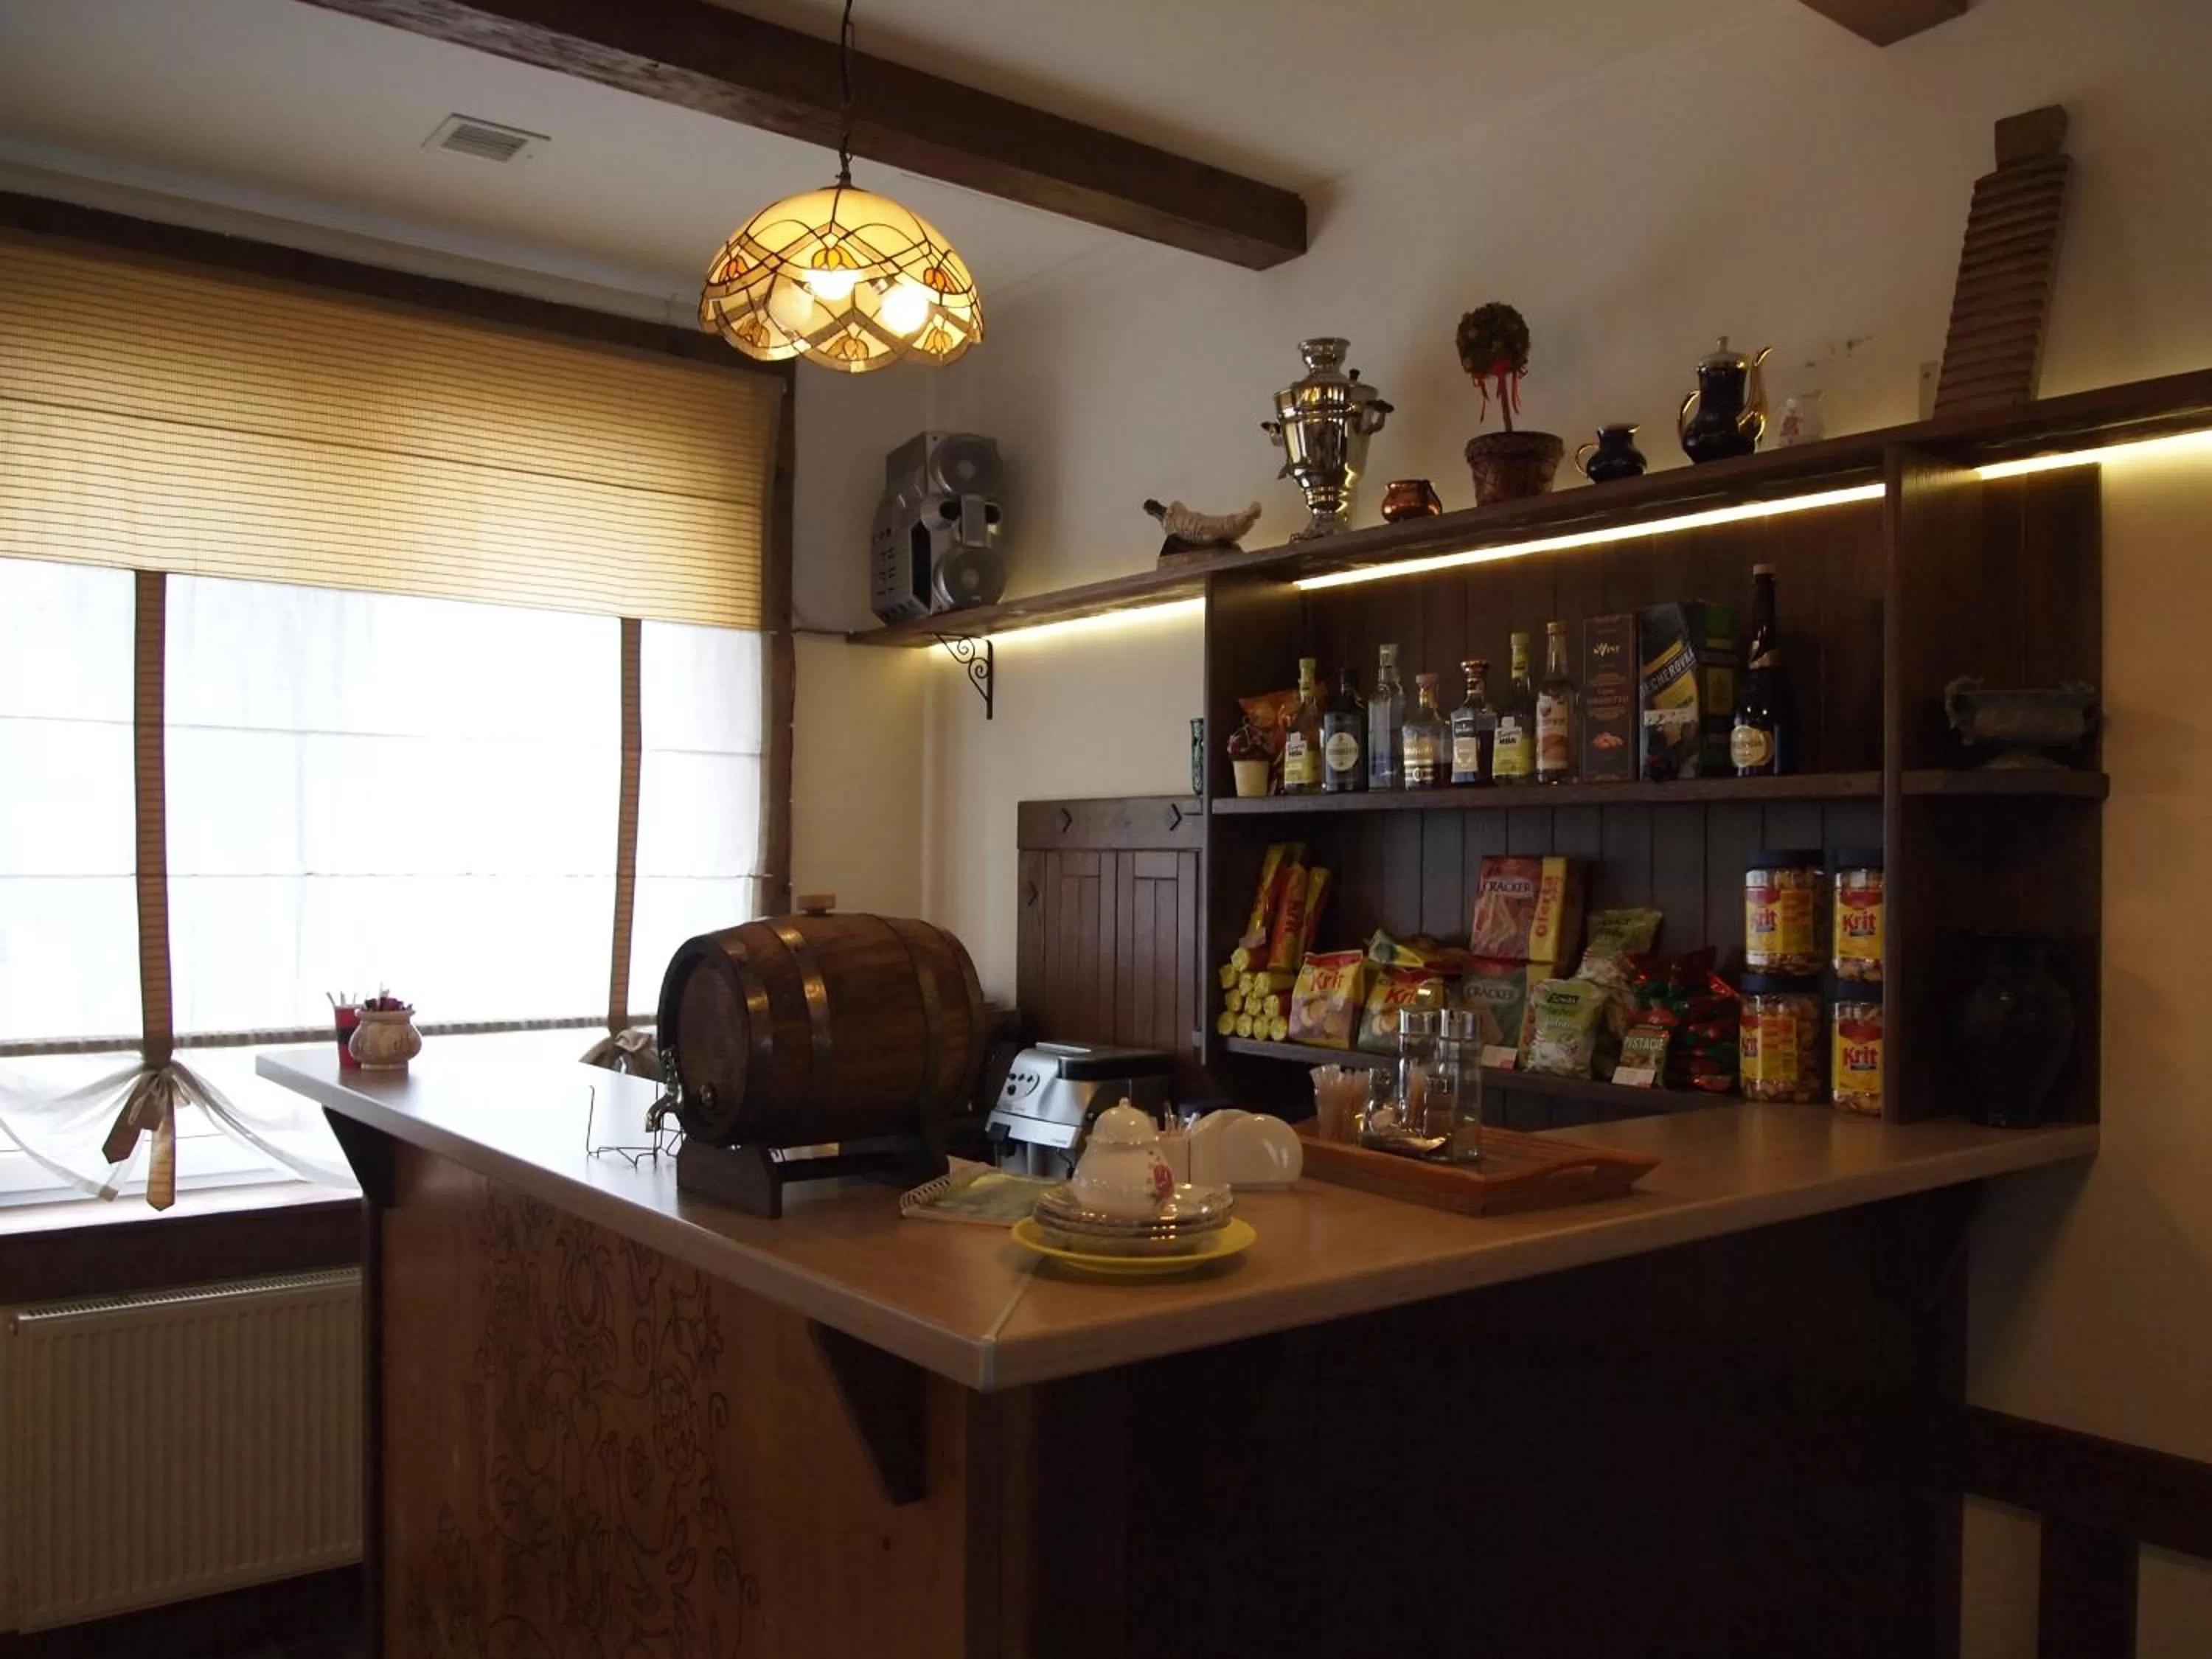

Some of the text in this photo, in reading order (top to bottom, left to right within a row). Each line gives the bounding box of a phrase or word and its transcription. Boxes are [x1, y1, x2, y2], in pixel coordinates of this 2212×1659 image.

[1843, 911, 1877, 933] Krit
[1310, 971, 1344, 992] Krit
[1467, 985, 1516, 1000] CRACKER
[1843, 1046, 1879, 1066] Krit
